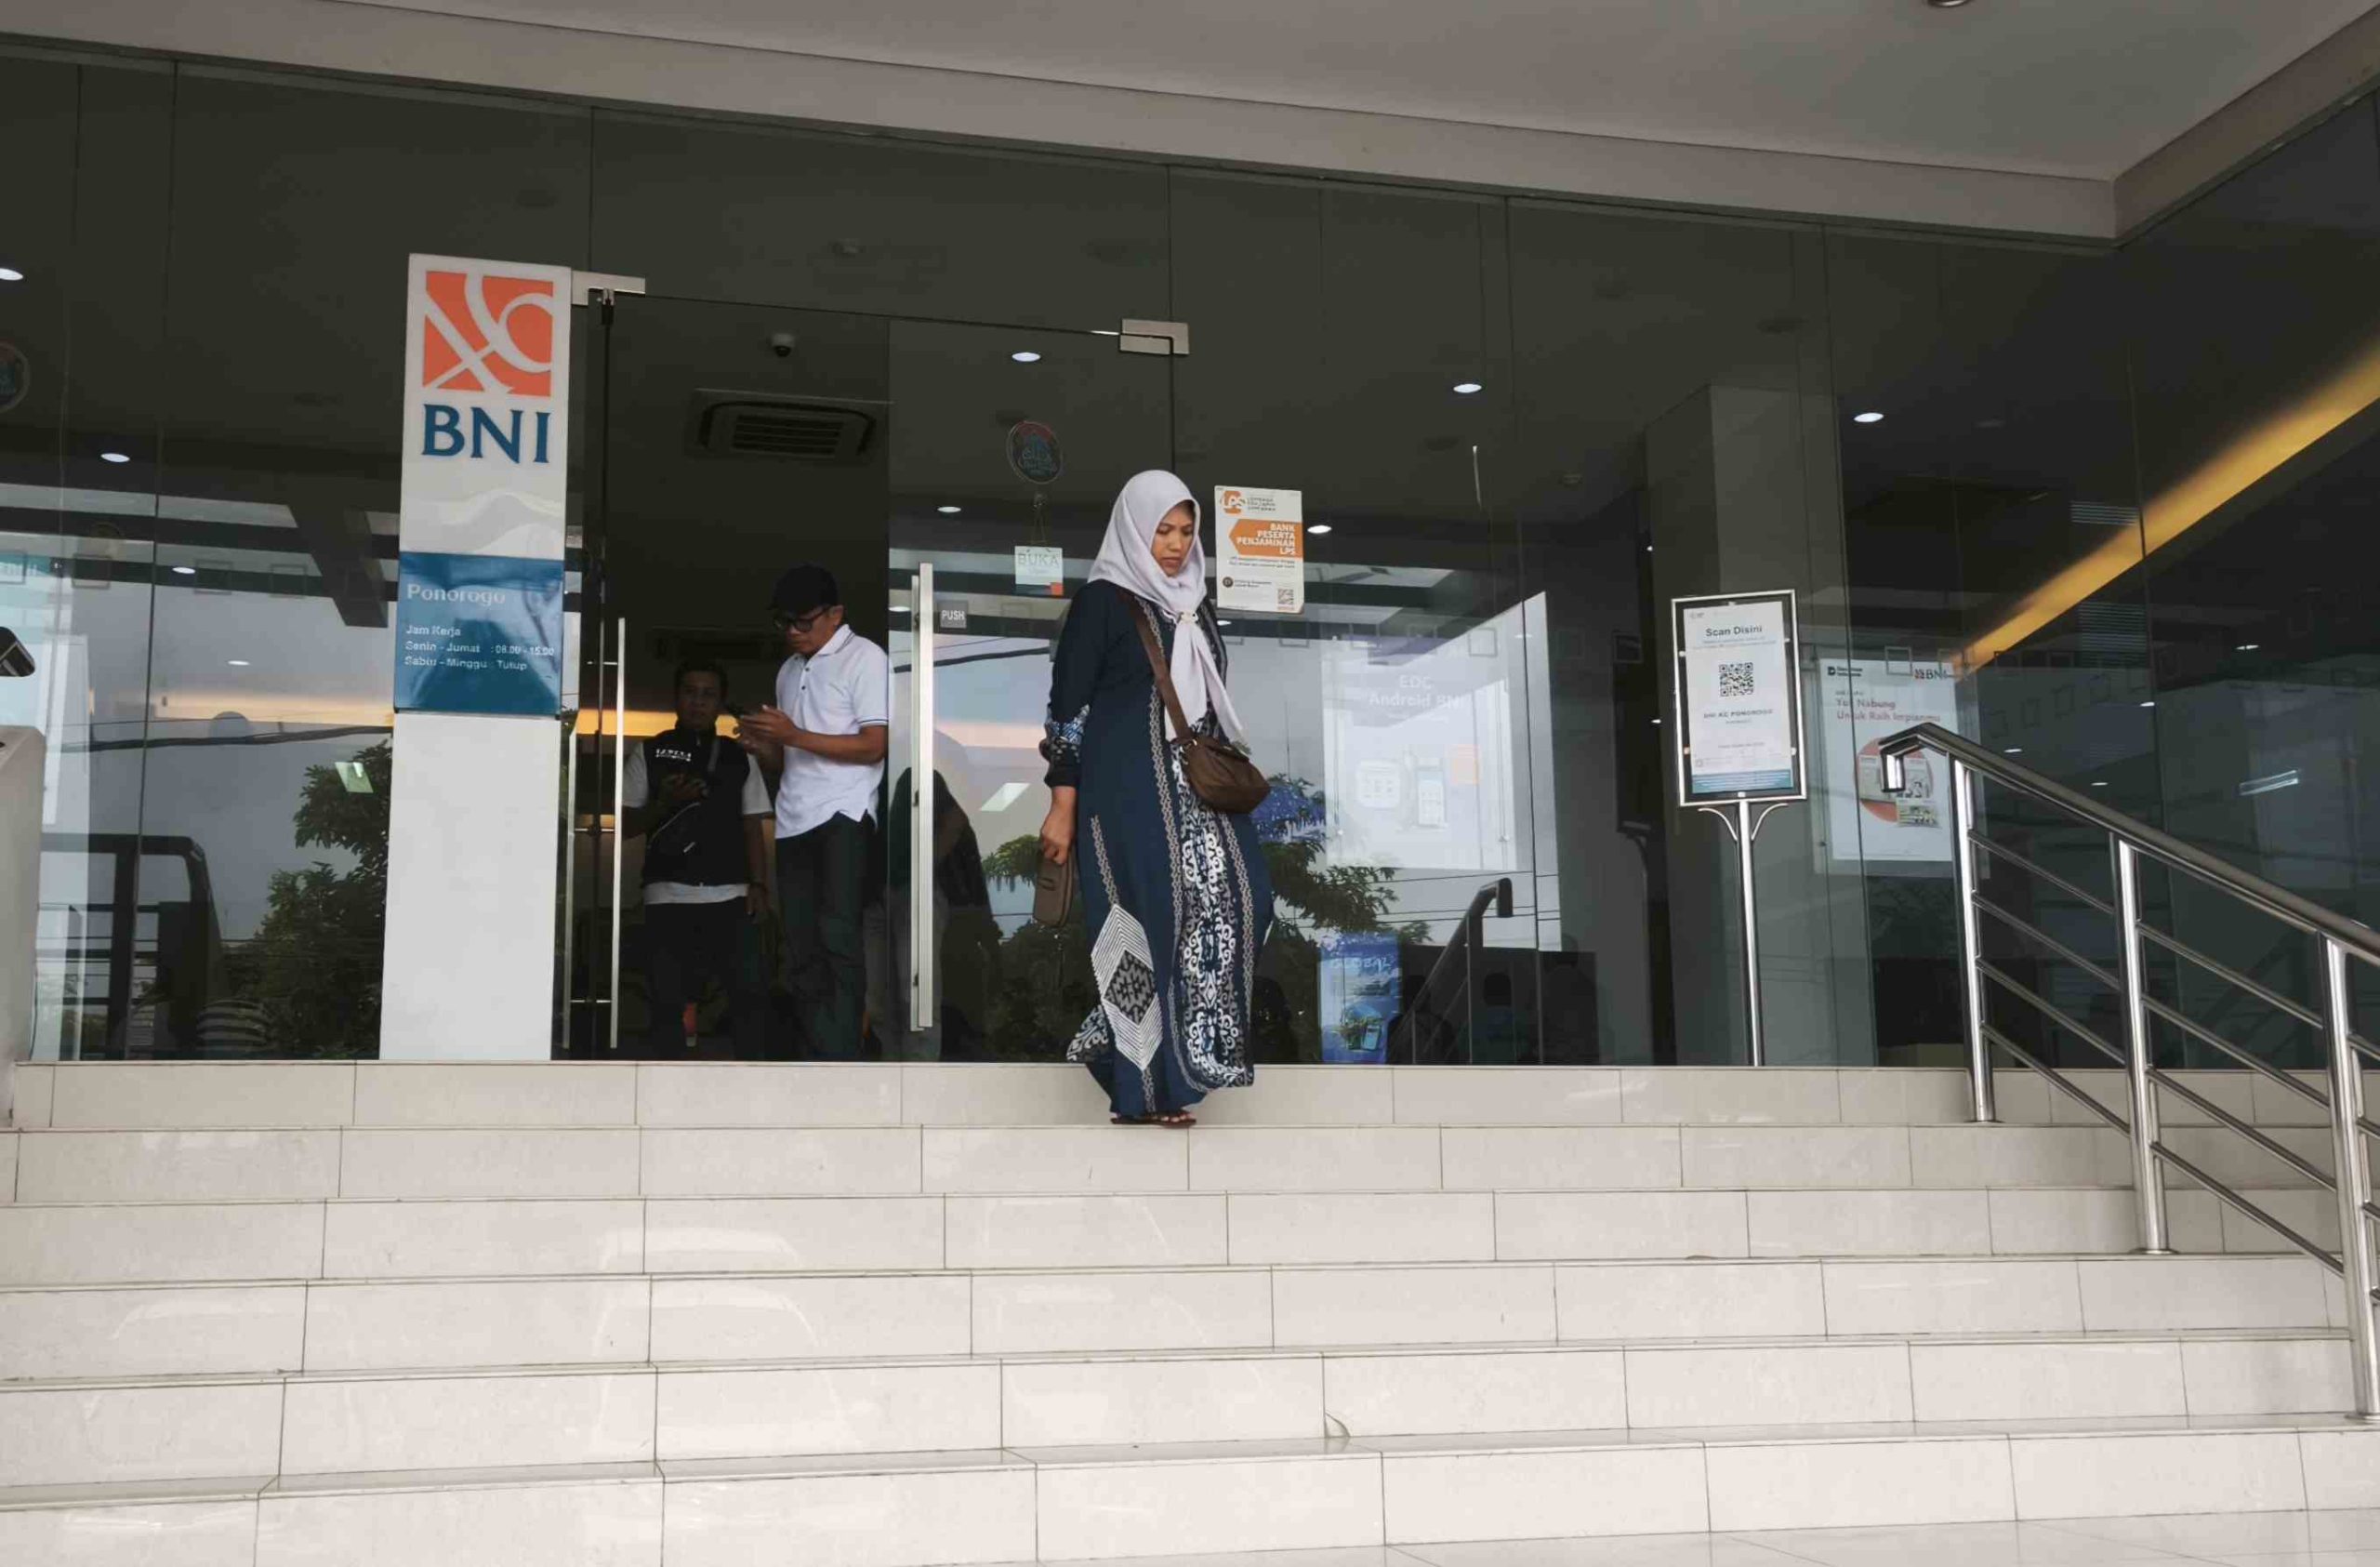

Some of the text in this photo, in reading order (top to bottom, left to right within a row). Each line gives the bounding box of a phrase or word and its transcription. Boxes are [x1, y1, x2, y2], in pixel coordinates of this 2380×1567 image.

[421, 404, 551, 464] BNI
[1018, 553, 1059, 566] BUKA
[407, 584, 507, 606] Ponorogo
[941, 610, 965, 620] PUSH
[405, 625, 461, 638] Jam Kerja
[1705, 624, 1764, 637] Scan Disini
[405, 641, 437, 652] Senin
[446, 643, 480, 653] Jumat
[404, 656, 437, 667] Sabtu
[446, 658, 487, 671] Minggu
[496, 659, 527, 671] Tutup
[1400, 675, 1433, 689] EDC
[1368, 692, 1432, 707] Android
[1858, 699, 1896, 710] Nabung
